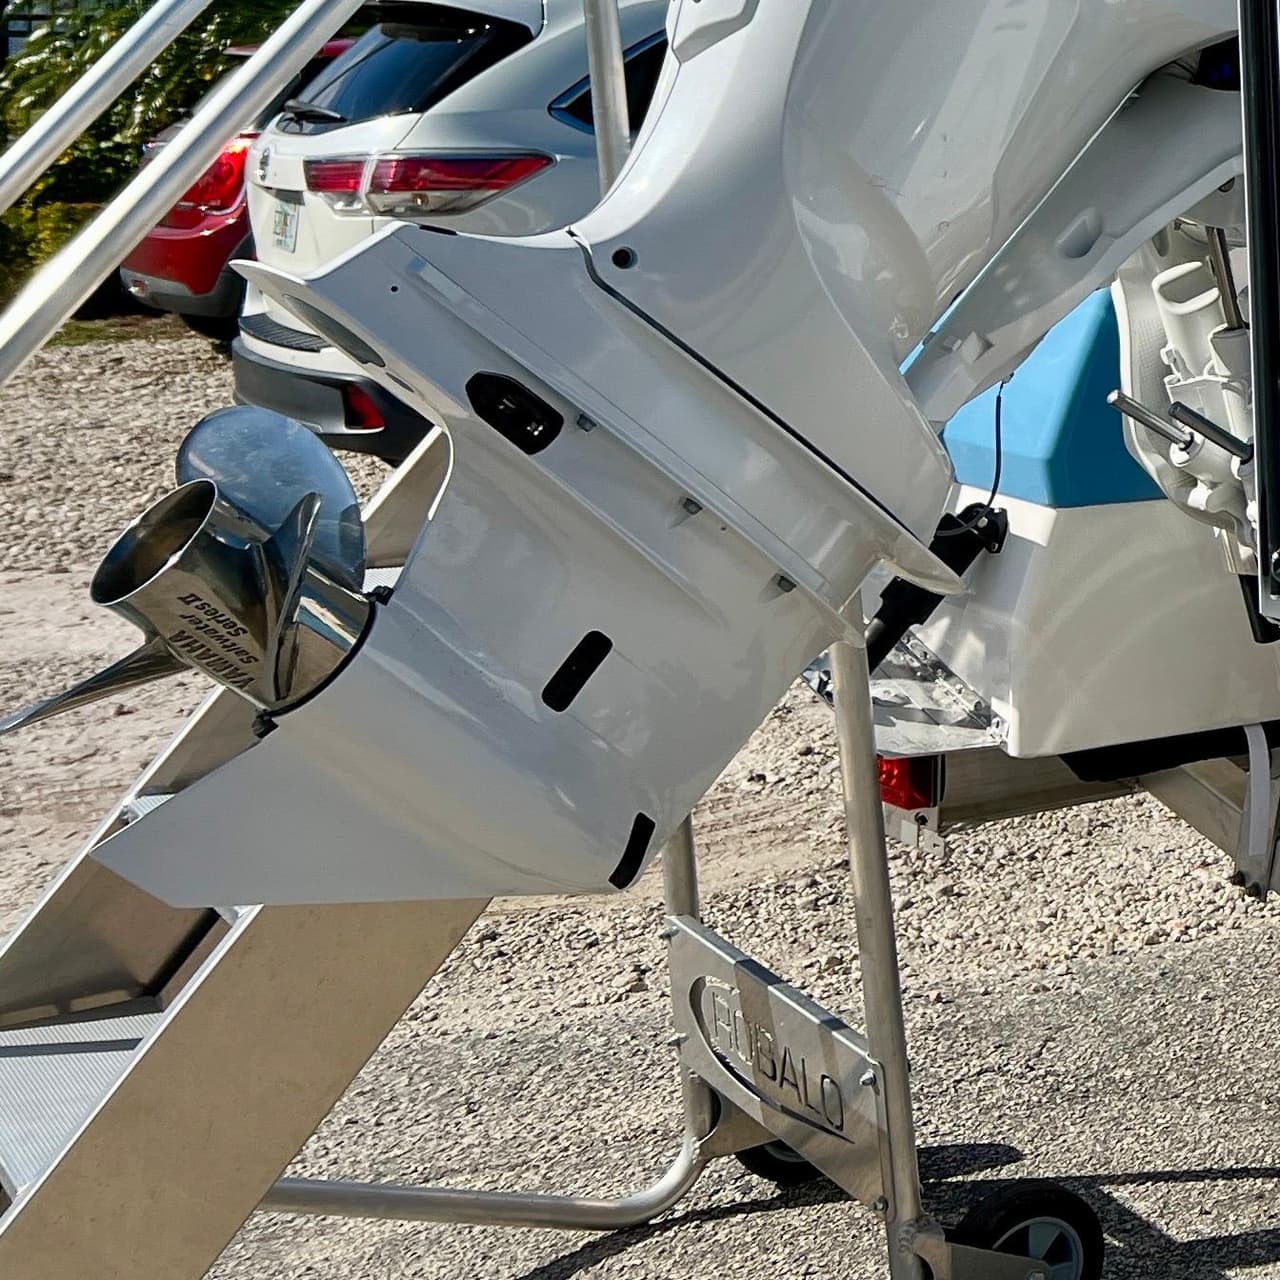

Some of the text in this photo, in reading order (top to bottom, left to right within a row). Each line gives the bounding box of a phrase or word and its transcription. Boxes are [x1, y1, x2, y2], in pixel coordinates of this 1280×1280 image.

[168, 629, 256, 690] YAMAHA
[179, 614, 260, 664] Saltwater
[711, 991, 845, 1132] ROBALO
